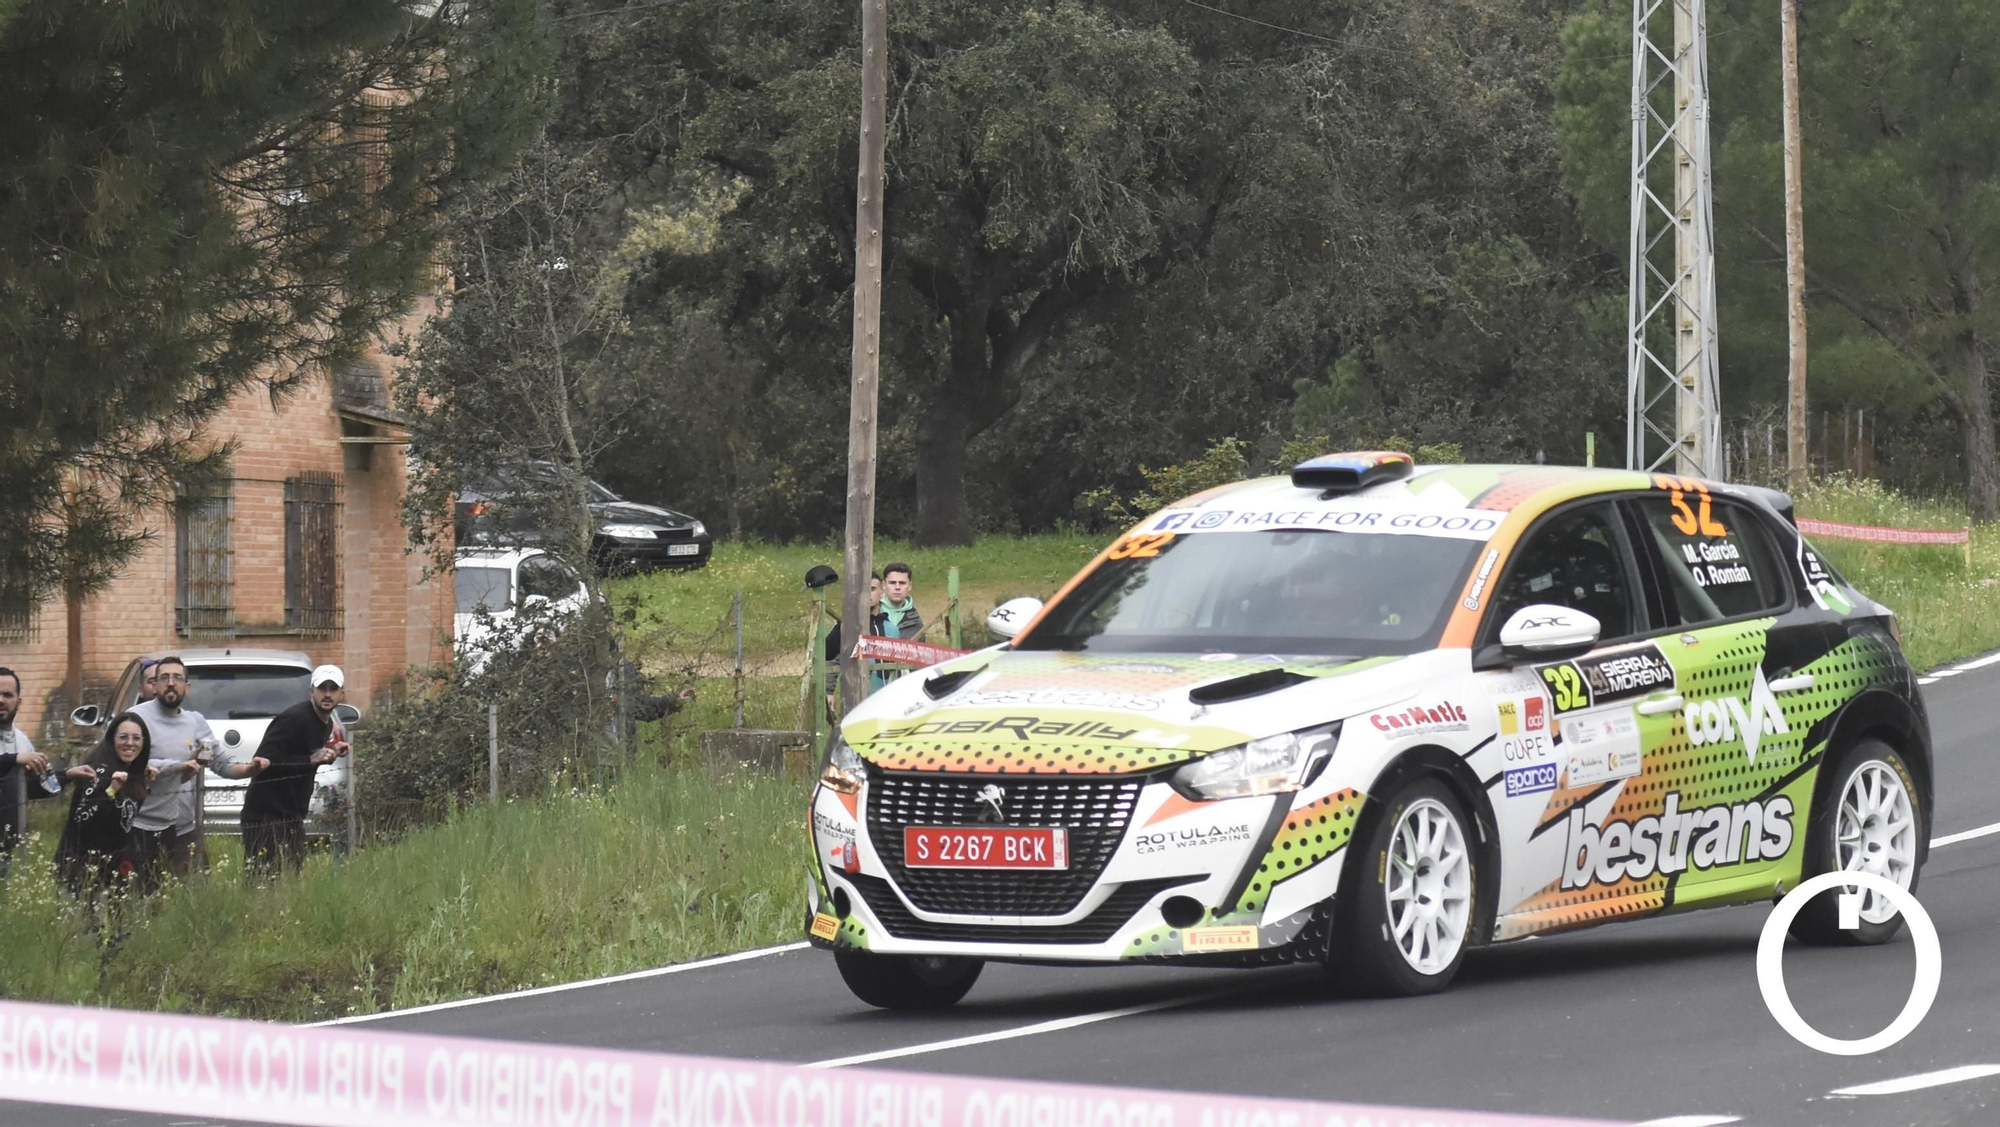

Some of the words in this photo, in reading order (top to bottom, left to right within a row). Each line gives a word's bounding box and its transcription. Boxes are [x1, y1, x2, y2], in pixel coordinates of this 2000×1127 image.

[1653, 475, 1727, 537] 32
[1233, 511, 1314, 525] RACE
[1316, 511, 1382, 526] FOR
[1390, 514, 1496, 532] GOOD
[1108, 531, 1176, 560] 32
[1681, 543, 1702, 563] M.
[1692, 566, 1710, 587] O.
[1707, 562, 1752, 585] Román
[1519, 616, 1572, 630] ARC
[1600, 655, 1656, 678] SIERRA
[1542, 664, 1588, 711] 32
[1607, 666, 1672, 693] MORENA
[1507, 766, 1556, 796] sparco
[1136, 824, 1249, 847] ROTULA.ME
[1137, 845, 1166, 855] CAR
[1176, 833, 1251, 848] WRAPPING
[1560, 792, 1795, 891] bestrans
[917, 834, 929, 860] S
[939, 835, 994, 861] 2267
[1004, 836, 1047, 862] BCK
[814, 917, 837, 936] PIRELLI
[1190, 930, 1250, 945] PIRELLI
